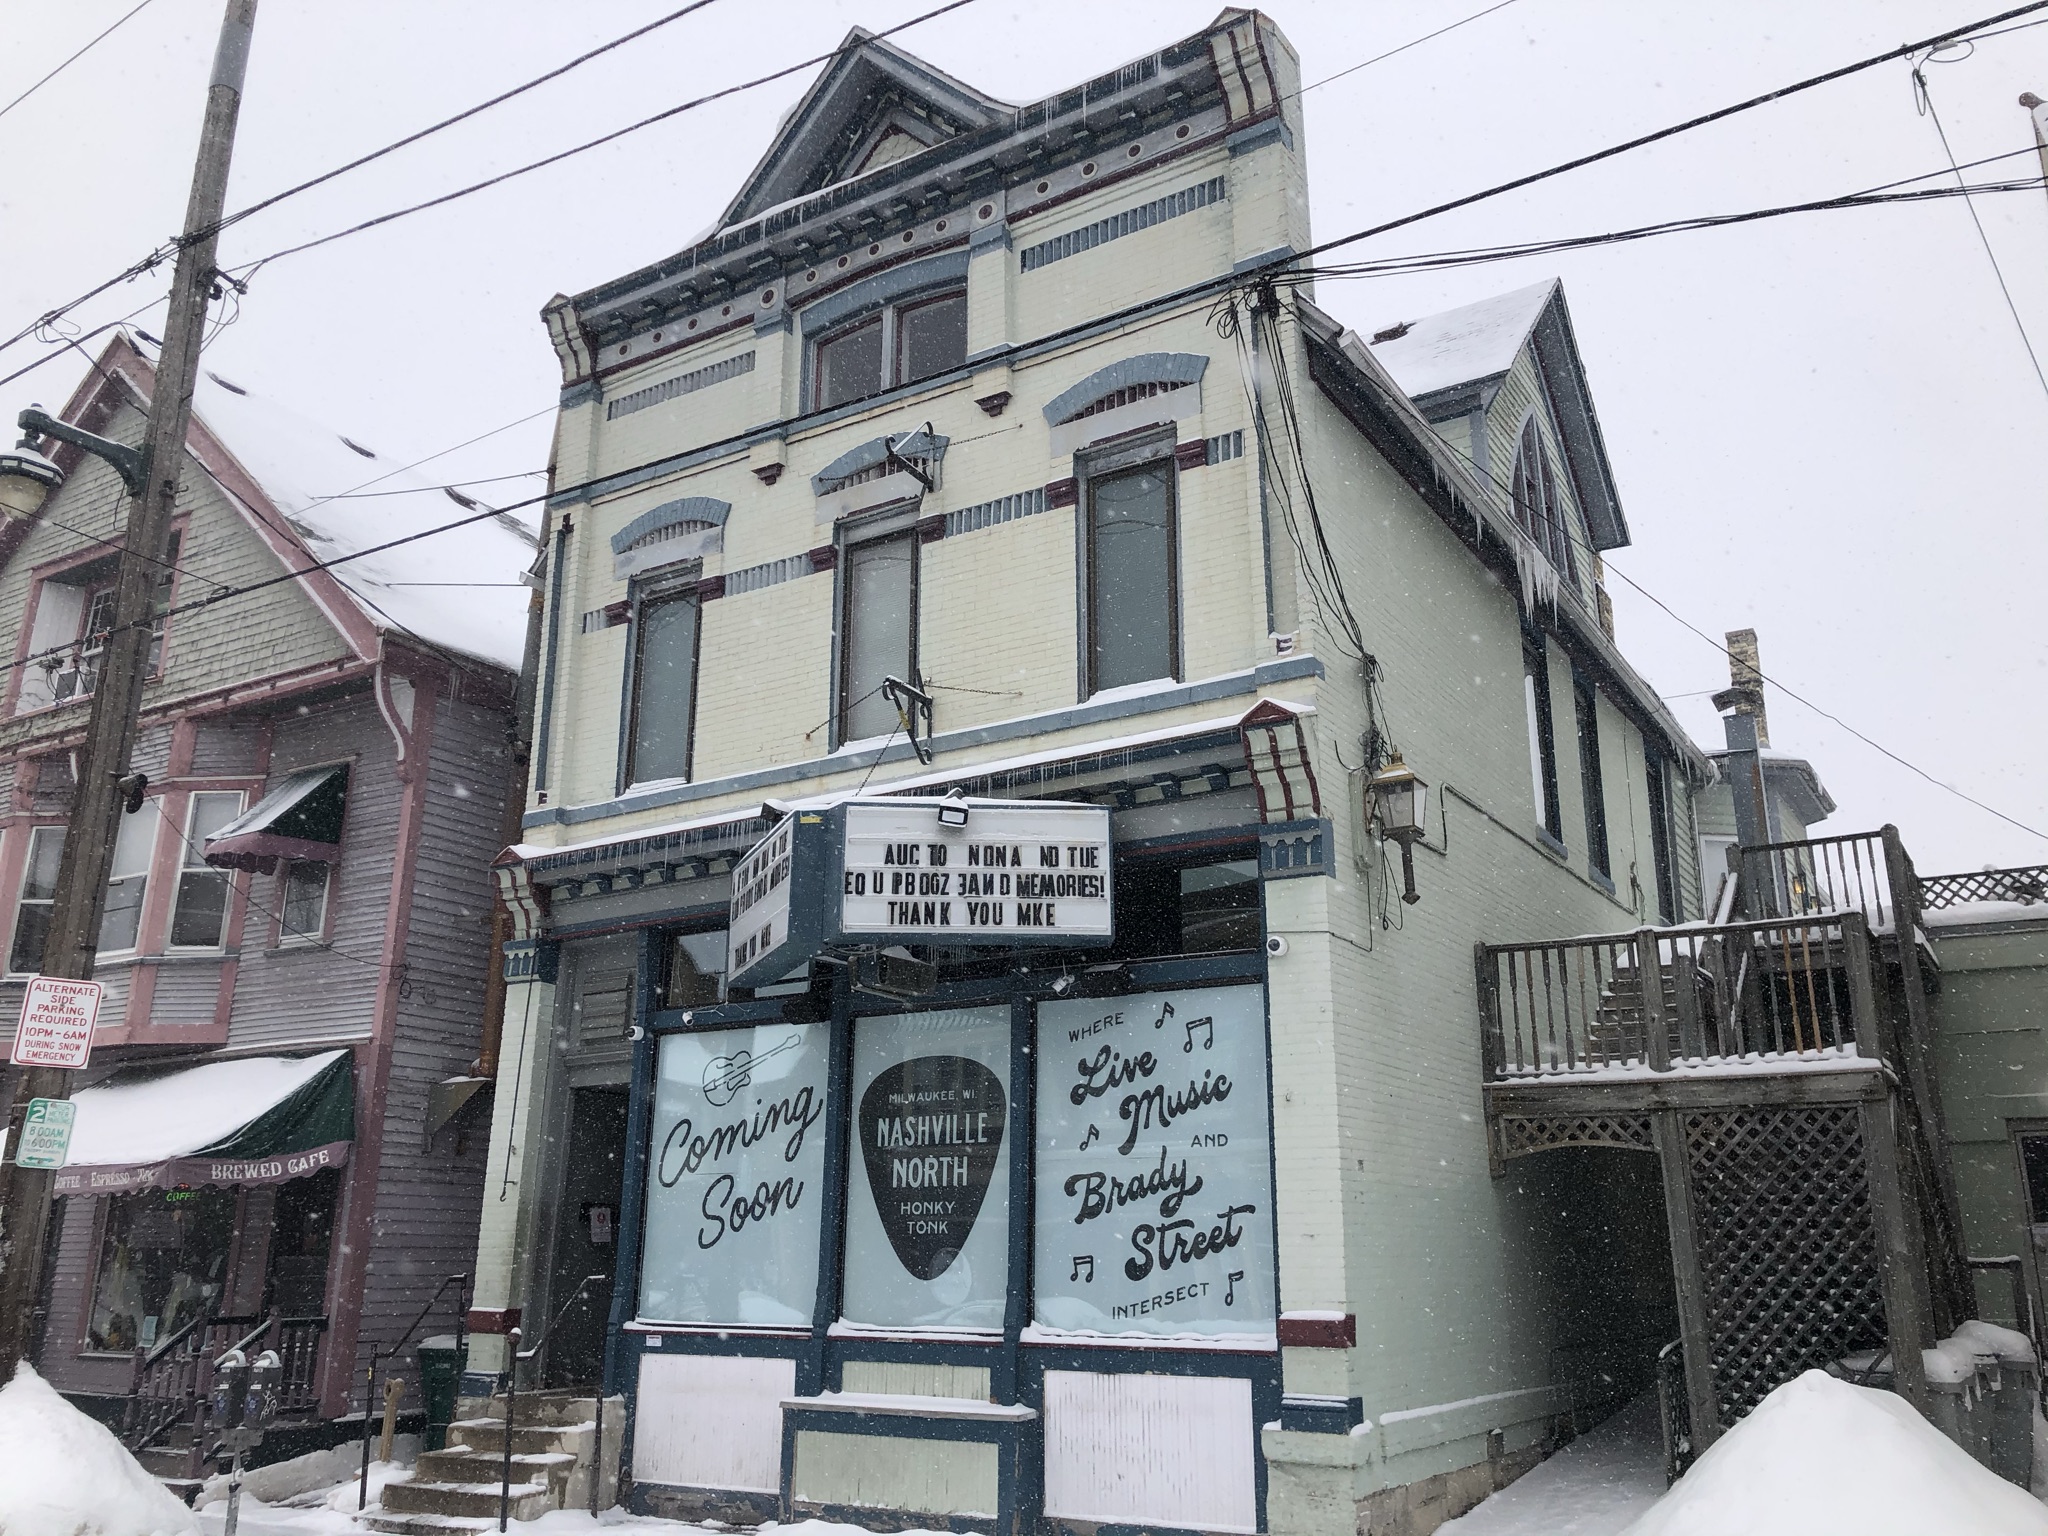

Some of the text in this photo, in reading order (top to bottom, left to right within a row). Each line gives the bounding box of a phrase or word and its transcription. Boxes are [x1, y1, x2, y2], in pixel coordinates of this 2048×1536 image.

[1016, 872, 1106, 898] MEMORIES!
[888, 901, 1056, 927] THANK YOU MKE
[34, 983, 97, 997] ALTERNATE
[50, 994, 77, 1005] SIDE
[30, 1013, 88, 1027] REQUIRED
[37, 1003, 85, 1016] PARKING
[24, 1026, 54, 1038] 10PM
[62, 1030, 87, 1041] 6AM
[1068, 1012, 1125, 1043] WHERE
[24, 1039, 82, 1052] DURING SNOW
[25, 1049, 76, 1062] EMERGENCY
[1070, 1044, 1158, 1106] Live
[29, 1106, 46, 1122] 2
[1117, 1068, 1233, 1156] Music
[658, 1085, 824, 1188] Coming
[877, 1112, 988, 1148] NASHVILLE
[1190, 1134, 1229, 1148] AND
[211, 1150, 330, 1180] BREWED CAFE
[892, 1156, 968, 1188] NORTH
[166, 1191, 201, 1202] COFFEE
[1063, 1145, 1204, 1225] Brady
[697, 1174, 804, 1249] Soon
[900, 1201, 956, 1215] HONKY
[906, 1220, 948, 1235] TONK
[1124, 1204, 1256, 1282] Street
[1111, 1282, 1210, 1320] INTERSECT
